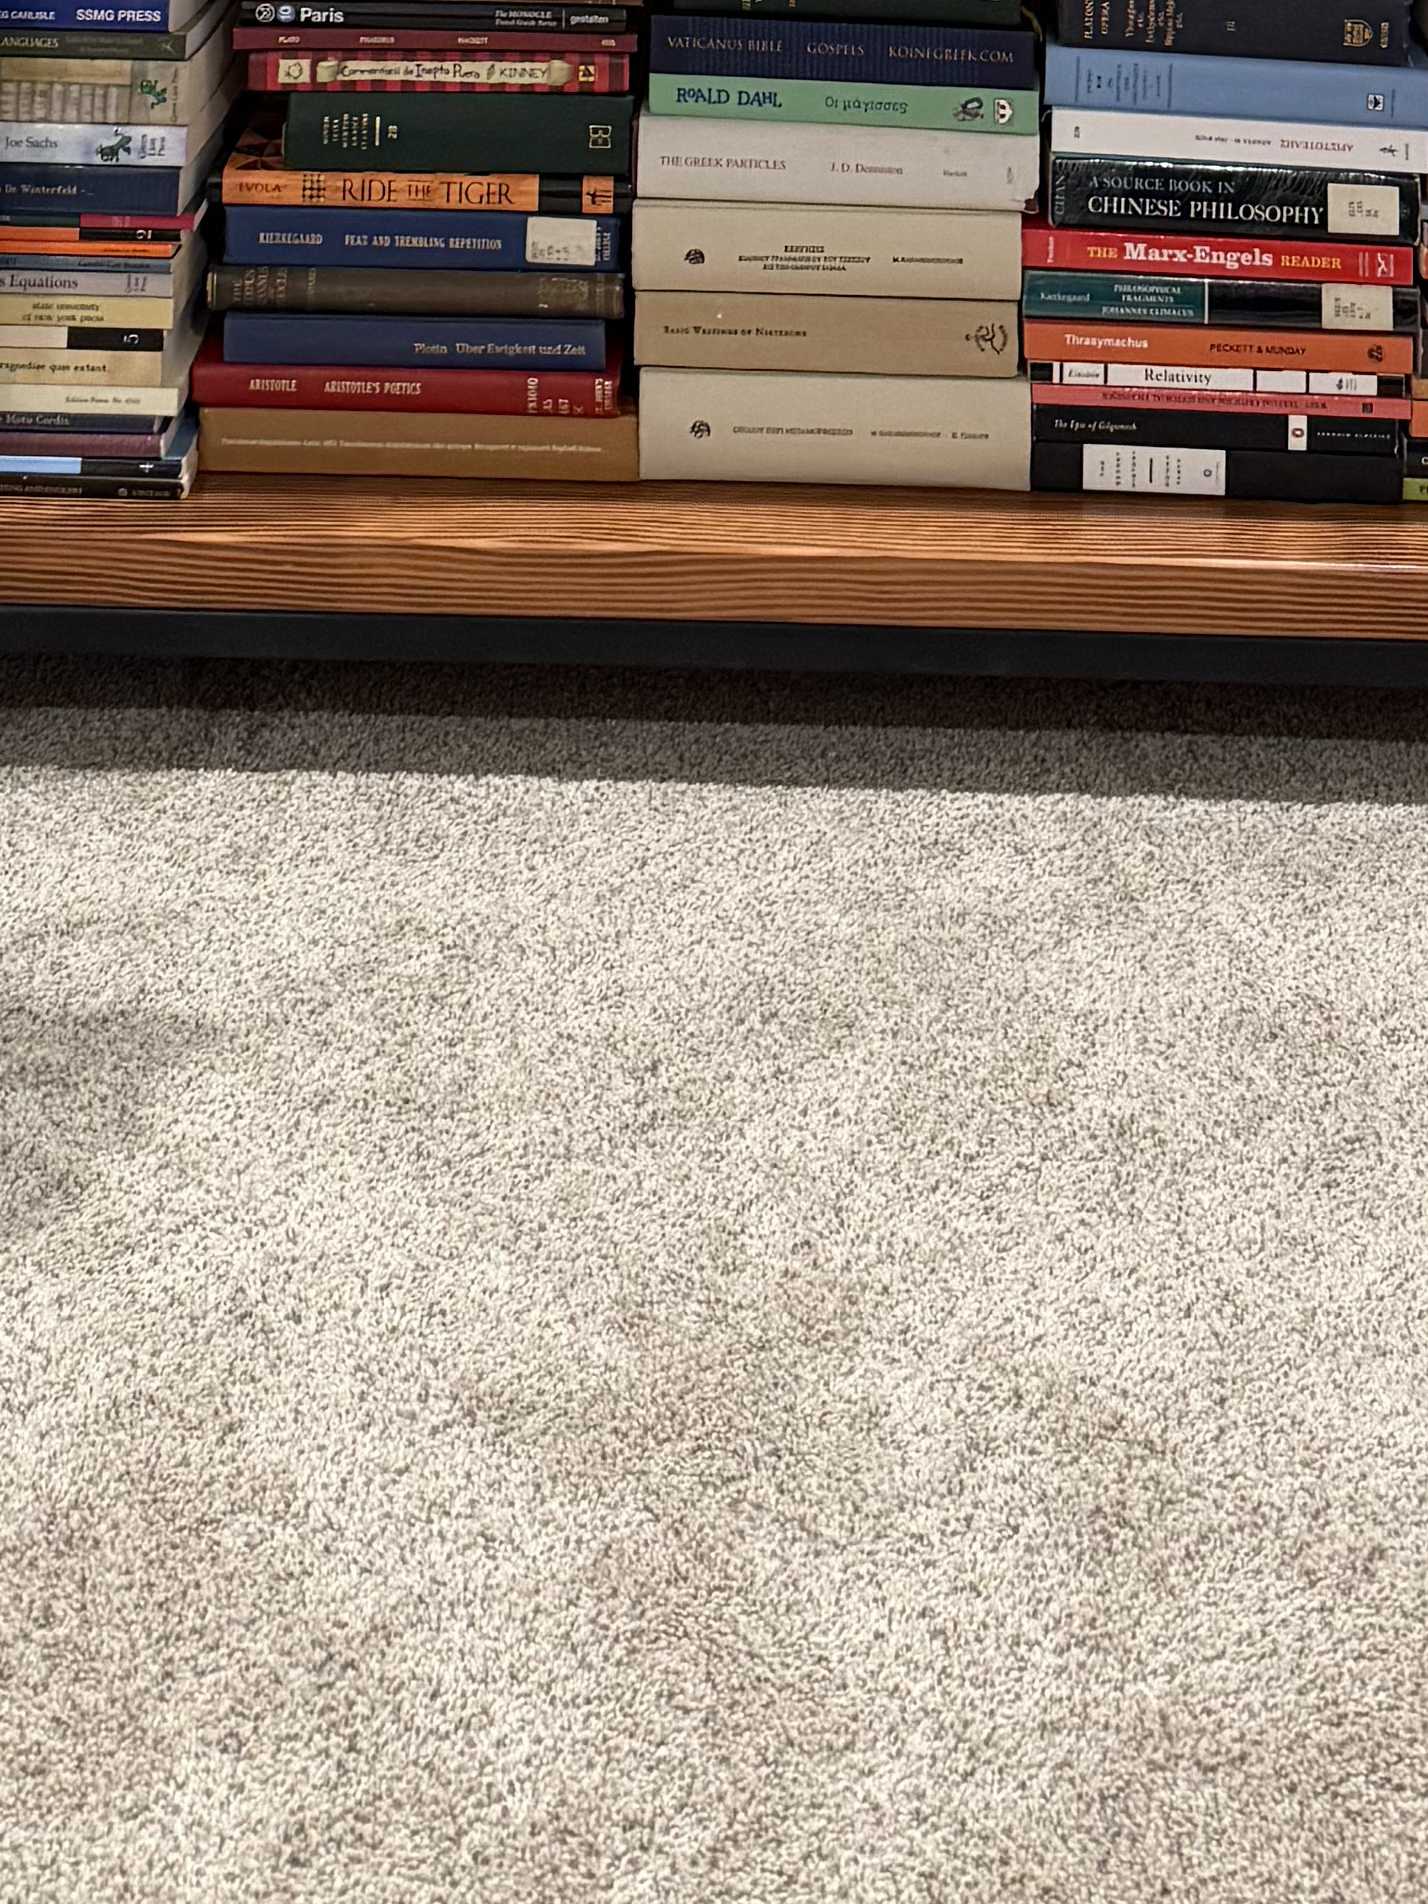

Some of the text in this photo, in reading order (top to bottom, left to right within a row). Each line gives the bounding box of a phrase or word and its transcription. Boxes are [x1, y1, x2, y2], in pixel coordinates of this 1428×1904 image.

[76, 9, 160, 23] SSMG PRESS
[300, 6, 344, 24] Paris
[341, 181, 514, 204] RIDE THE TIGER
[1088, 196, 1323, 225] CHINESE PHILOSOPHY
[1065, 333, 1148, 349] Thrasymachus
[1143, 368, 1212, 386] Relativity
